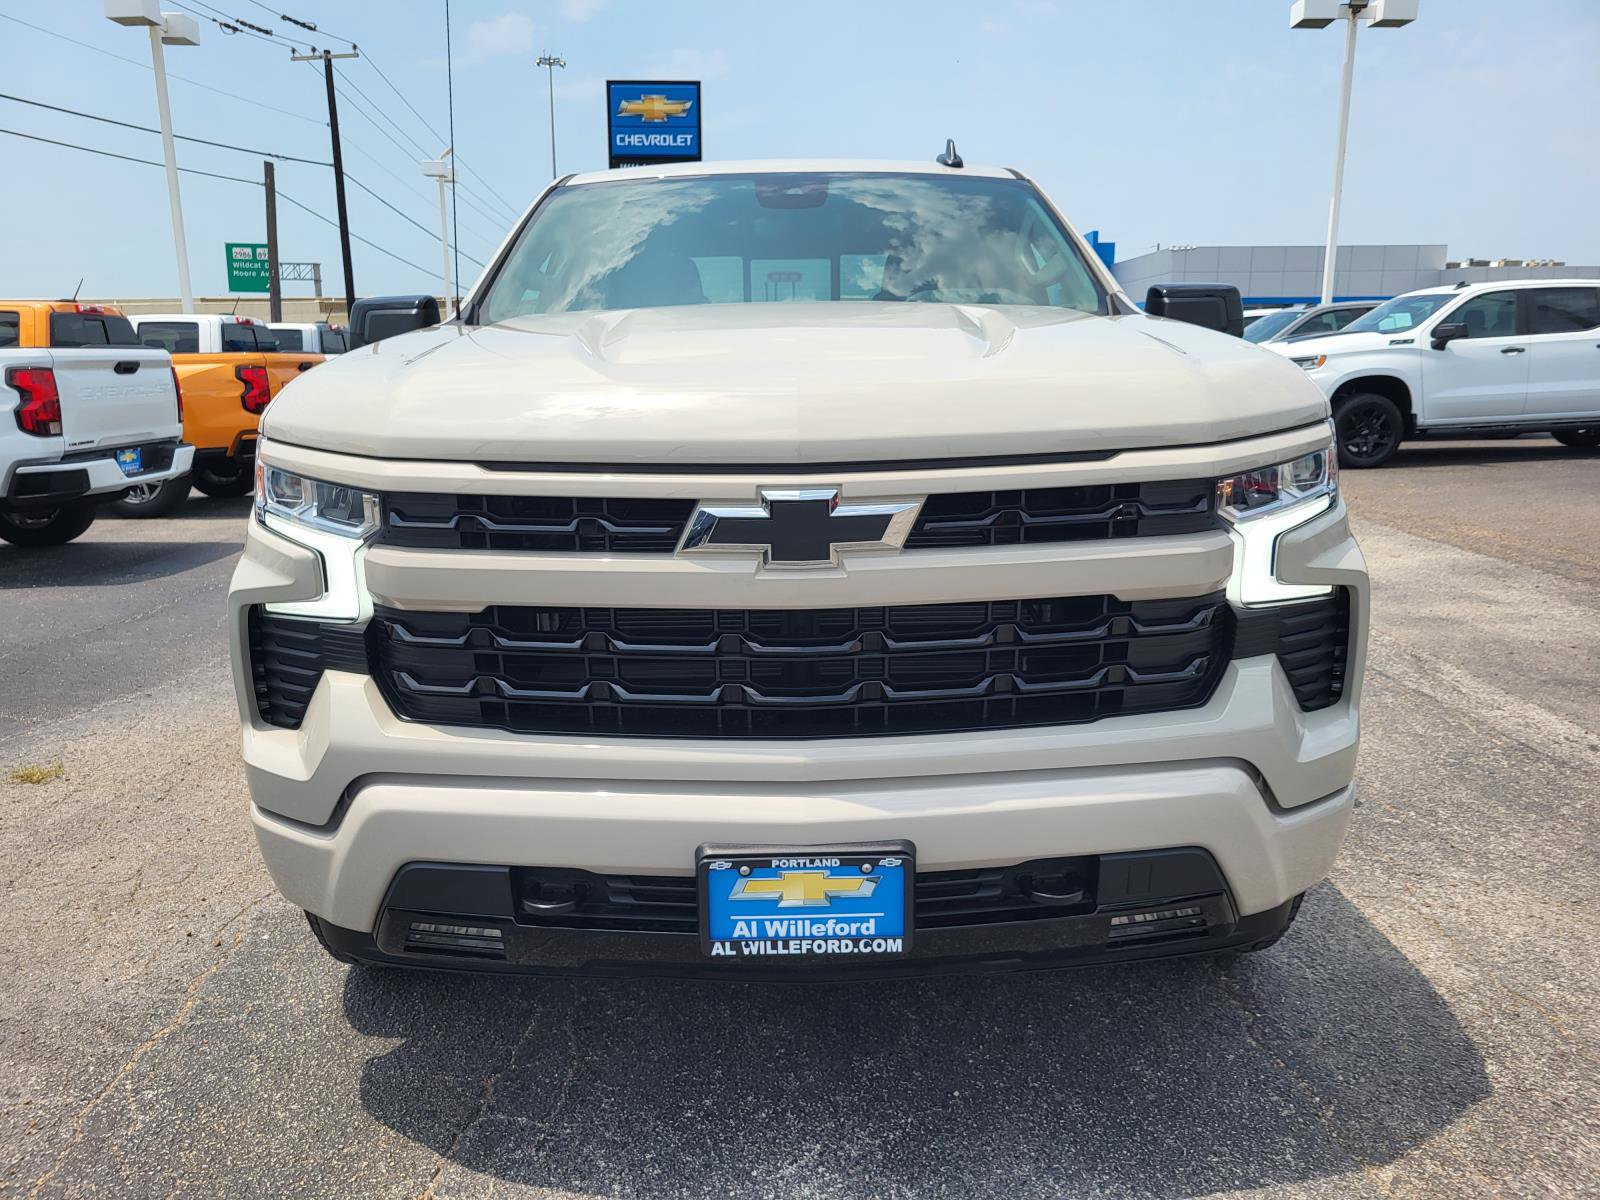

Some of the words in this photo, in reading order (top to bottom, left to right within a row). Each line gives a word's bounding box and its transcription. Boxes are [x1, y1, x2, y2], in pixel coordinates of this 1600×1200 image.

[616, 134, 693, 146] CHEVROLET
[234, 251, 252, 259] 2986
[232, 261, 261, 269] Wildcat
[771, 858, 841, 869] PORTLAND
[732, 920, 758, 938] Al
[764, 918, 876, 938] Willeford
[711, 941, 737, 956] AL
[741, 939, 903, 956] WILLEFORD.COM
